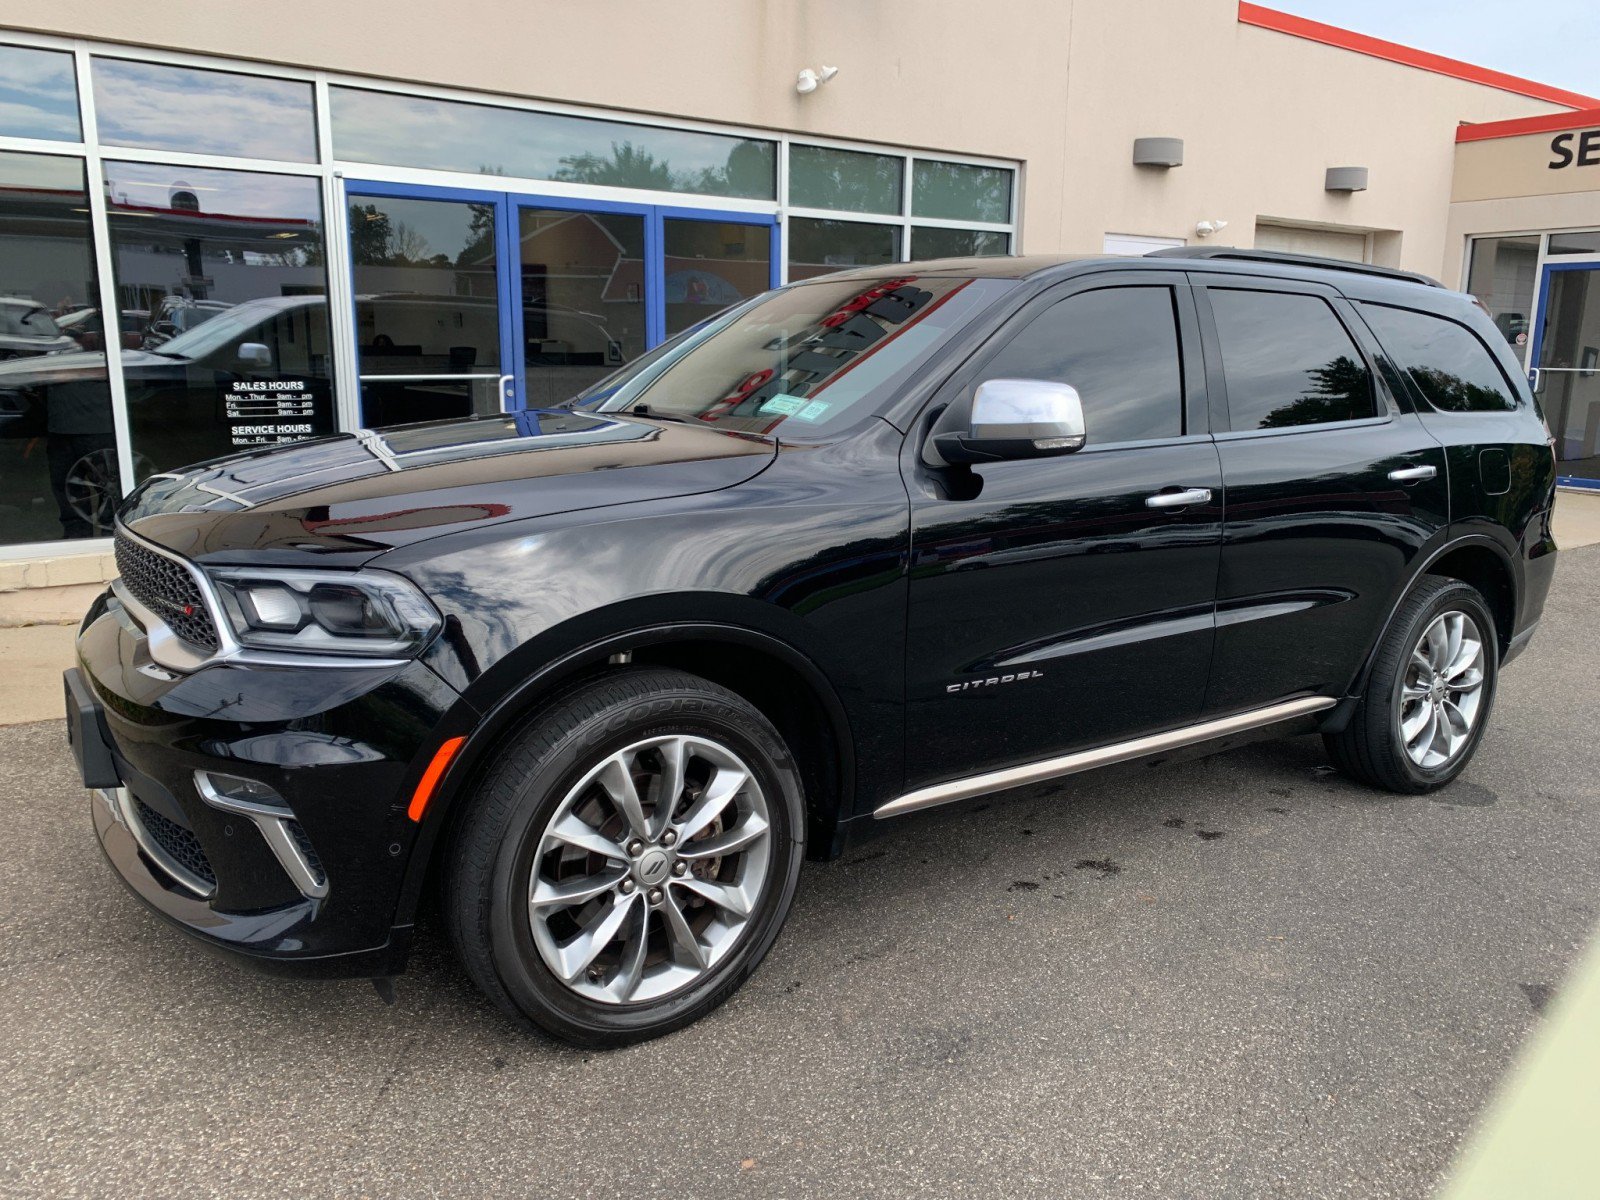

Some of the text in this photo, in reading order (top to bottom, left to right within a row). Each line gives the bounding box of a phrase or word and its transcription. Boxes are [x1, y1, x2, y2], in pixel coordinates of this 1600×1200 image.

[233, 381, 304, 391] SALES HOURS
[231, 424, 312, 435] SERVICE HOURS
[946, 670, 1044, 693] CITADEL
